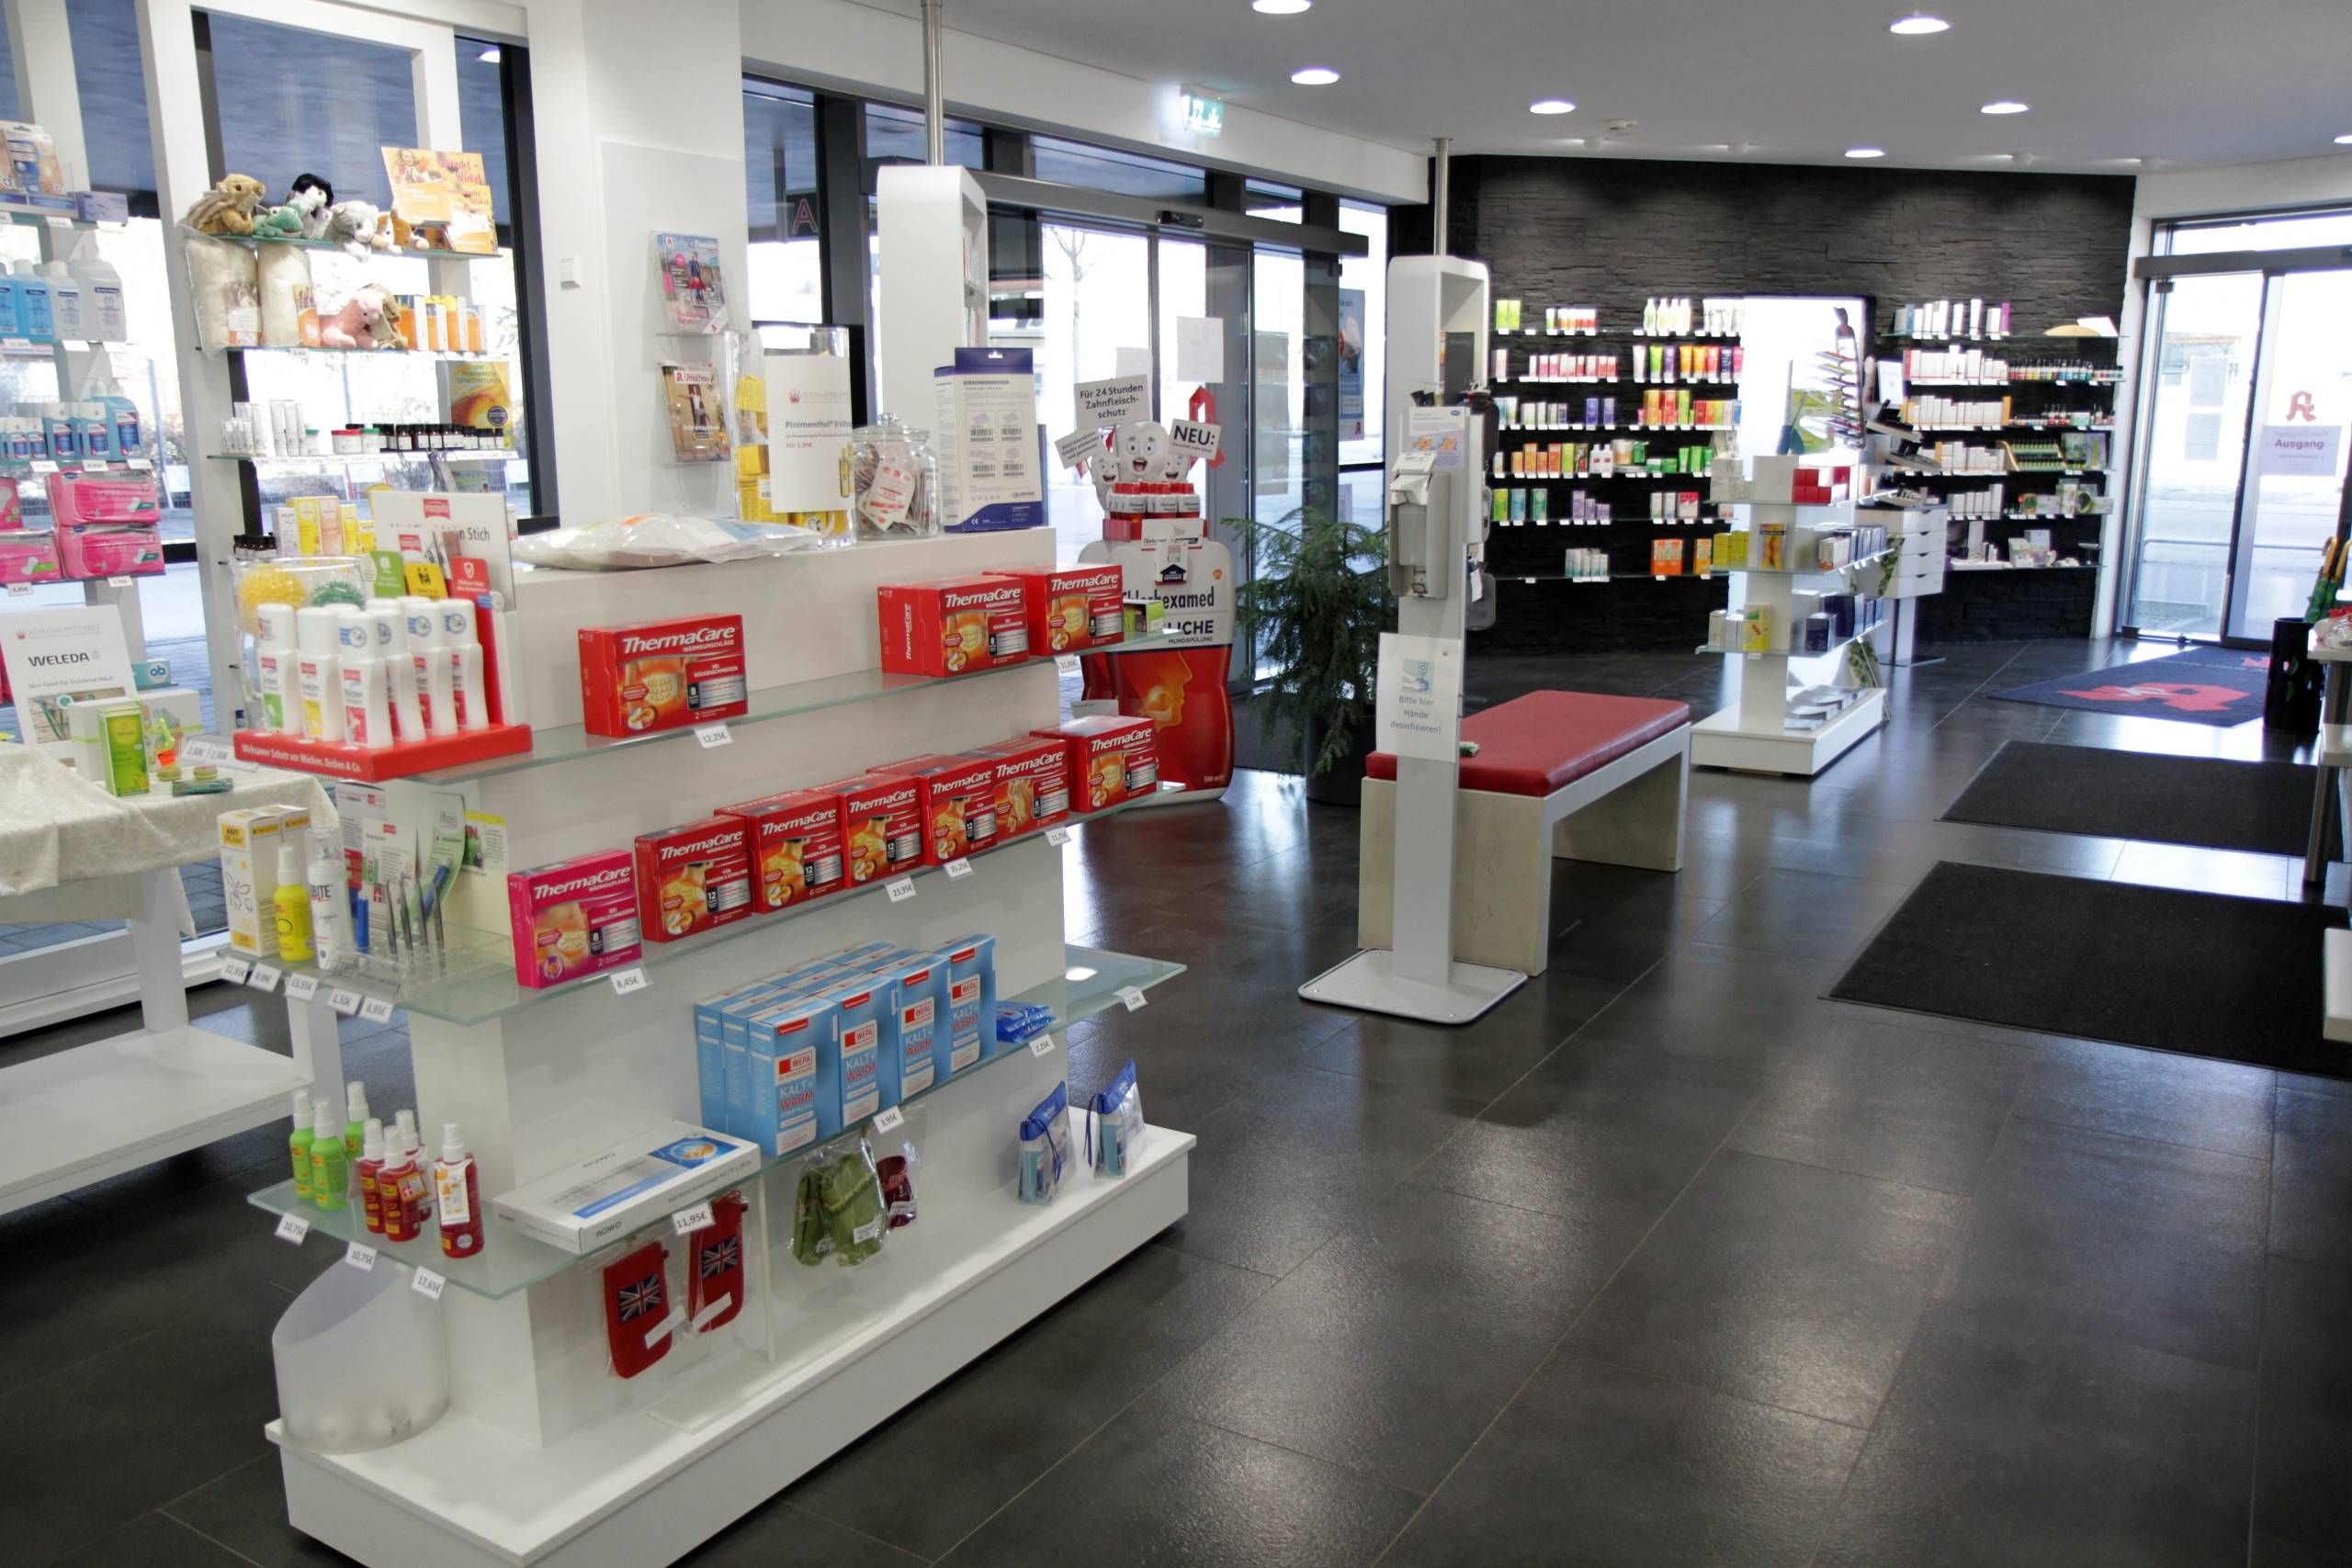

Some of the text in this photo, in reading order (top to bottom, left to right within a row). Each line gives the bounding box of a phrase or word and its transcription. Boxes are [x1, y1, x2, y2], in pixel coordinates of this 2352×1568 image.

[1080, 384, 1144, 399] Für 24 Stunden
[1086, 395, 1139, 410] Zahnfleisch-
[1173, 425, 1215, 446] NEU:
[2275, 439, 2324, 449] Ausgang
[468, 527, 490, 541] Stich
[1051, 574, 1118, 592] ThermaCare
[944, 588, 1021, 608] ThermaCare
[623, 626, 735, 654] ThermaCare
[28, 652, 90, 667] WELEDA
[1398, 695, 1418, 705] Bitte
[1404, 709, 1428, 718] Hände
[1091, 728, 1152, 751] ThermaCare
[242, 744, 270, 757] Wirksamer
[271, 748, 289, 761] Schutz
[290, 752, 300, 761] vor
[324, 757, 345, 770] Zecken
[352, 761, 362, 772] Co.
[996, 750, 1064, 779] ThermaCare
[932, 770, 992, 795] ThermaCare
[849, 788, 917, 814] ThermaCare
[762, 808, 837, 836] ThermaCare
[661, 830, 743, 861] ThermaCare
[534, 866, 631, 899] ThermaCare
[707, 891, 717, 900] 12
[915, 1005, 931, 1017] WEPA
[953, 1016, 978, 1031] WARM
[856, 1028, 872, 1040] WEPA
[906, 1039, 933, 1055] WARM
[792, 1055, 811, 1068] WEPA
[846, 1063, 876, 1081] WARM
[780, 1090, 814, 1110] WARM
[676, 1211, 707, 1229] 11,95€
